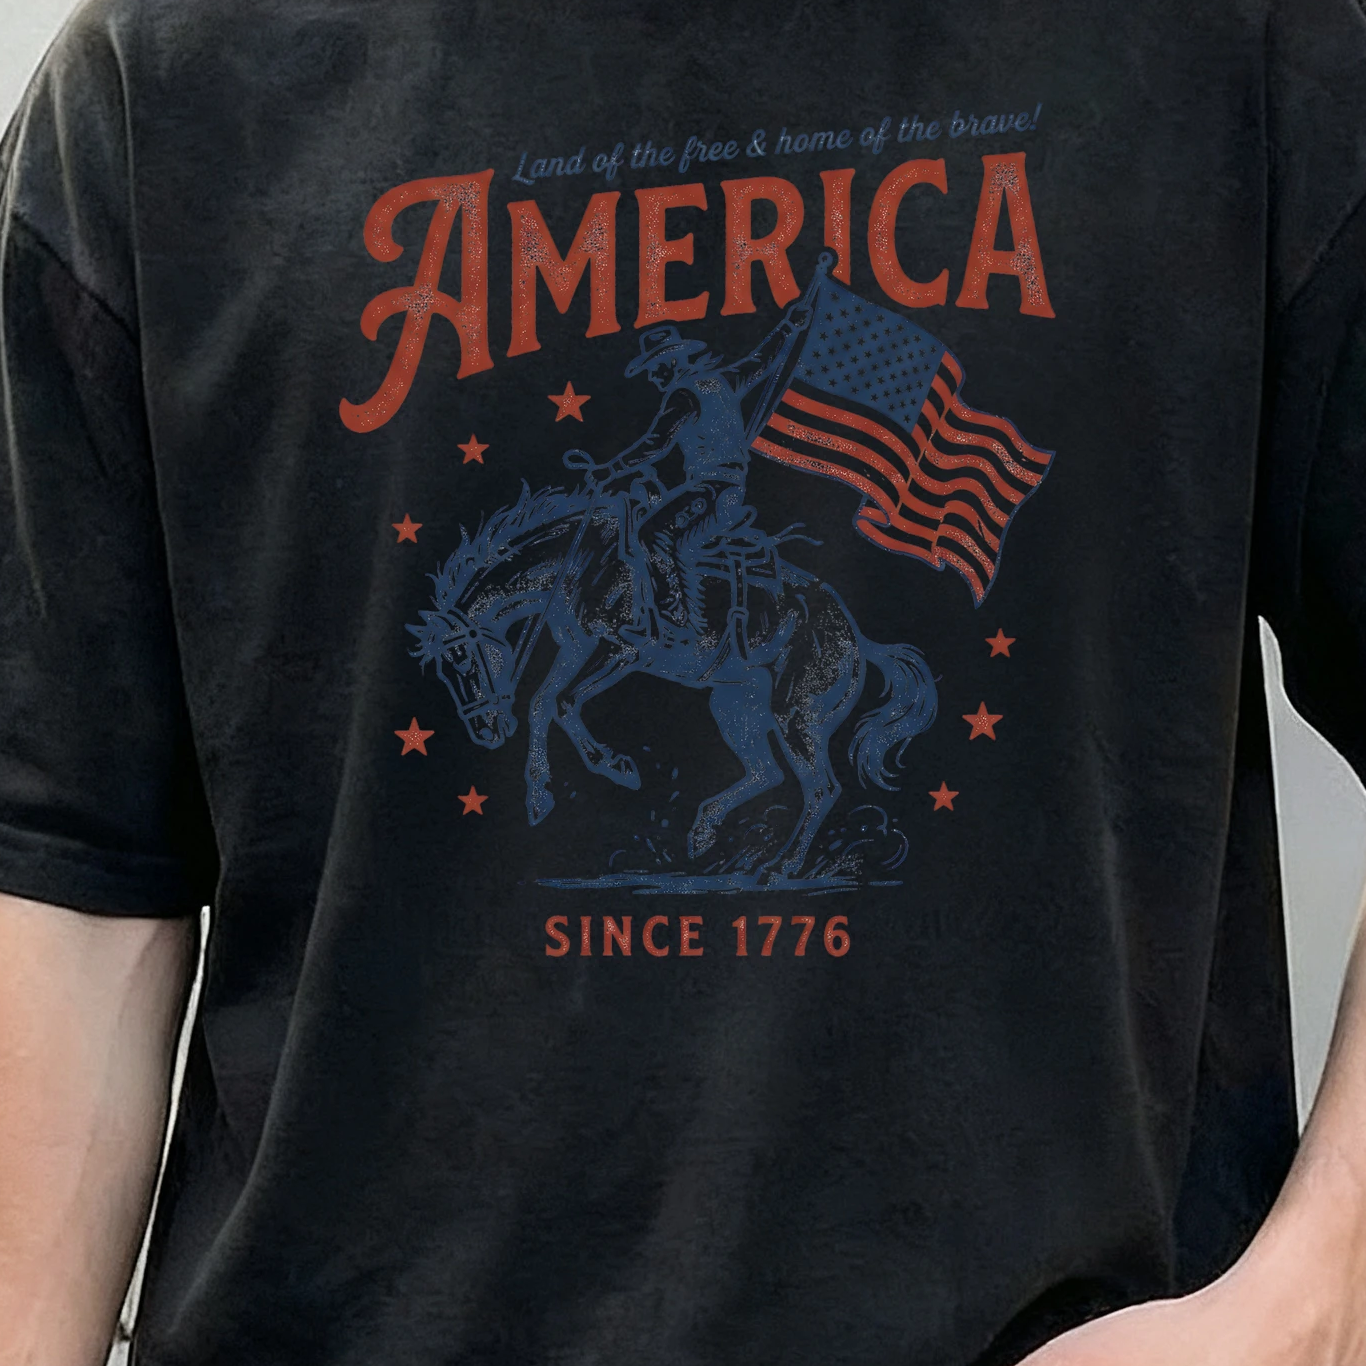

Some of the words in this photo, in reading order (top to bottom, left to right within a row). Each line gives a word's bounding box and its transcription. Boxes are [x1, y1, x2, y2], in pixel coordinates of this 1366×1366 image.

[512, 146, 586, 185] Land
[591, 141, 625, 181] of
[630, 140, 676, 169] the
[678, 135, 740, 174] free
[745, 128, 767, 158] &
[774, 126, 854, 155] home
[859, 116, 893, 155] of
[897, 114, 942, 143] the
[948, 102, 1043, 137] brave!
[338, 151, 1057, 434] AMERICA
[544, 914, 705, 958] SINCE
[731, 914, 852, 958] 1776
